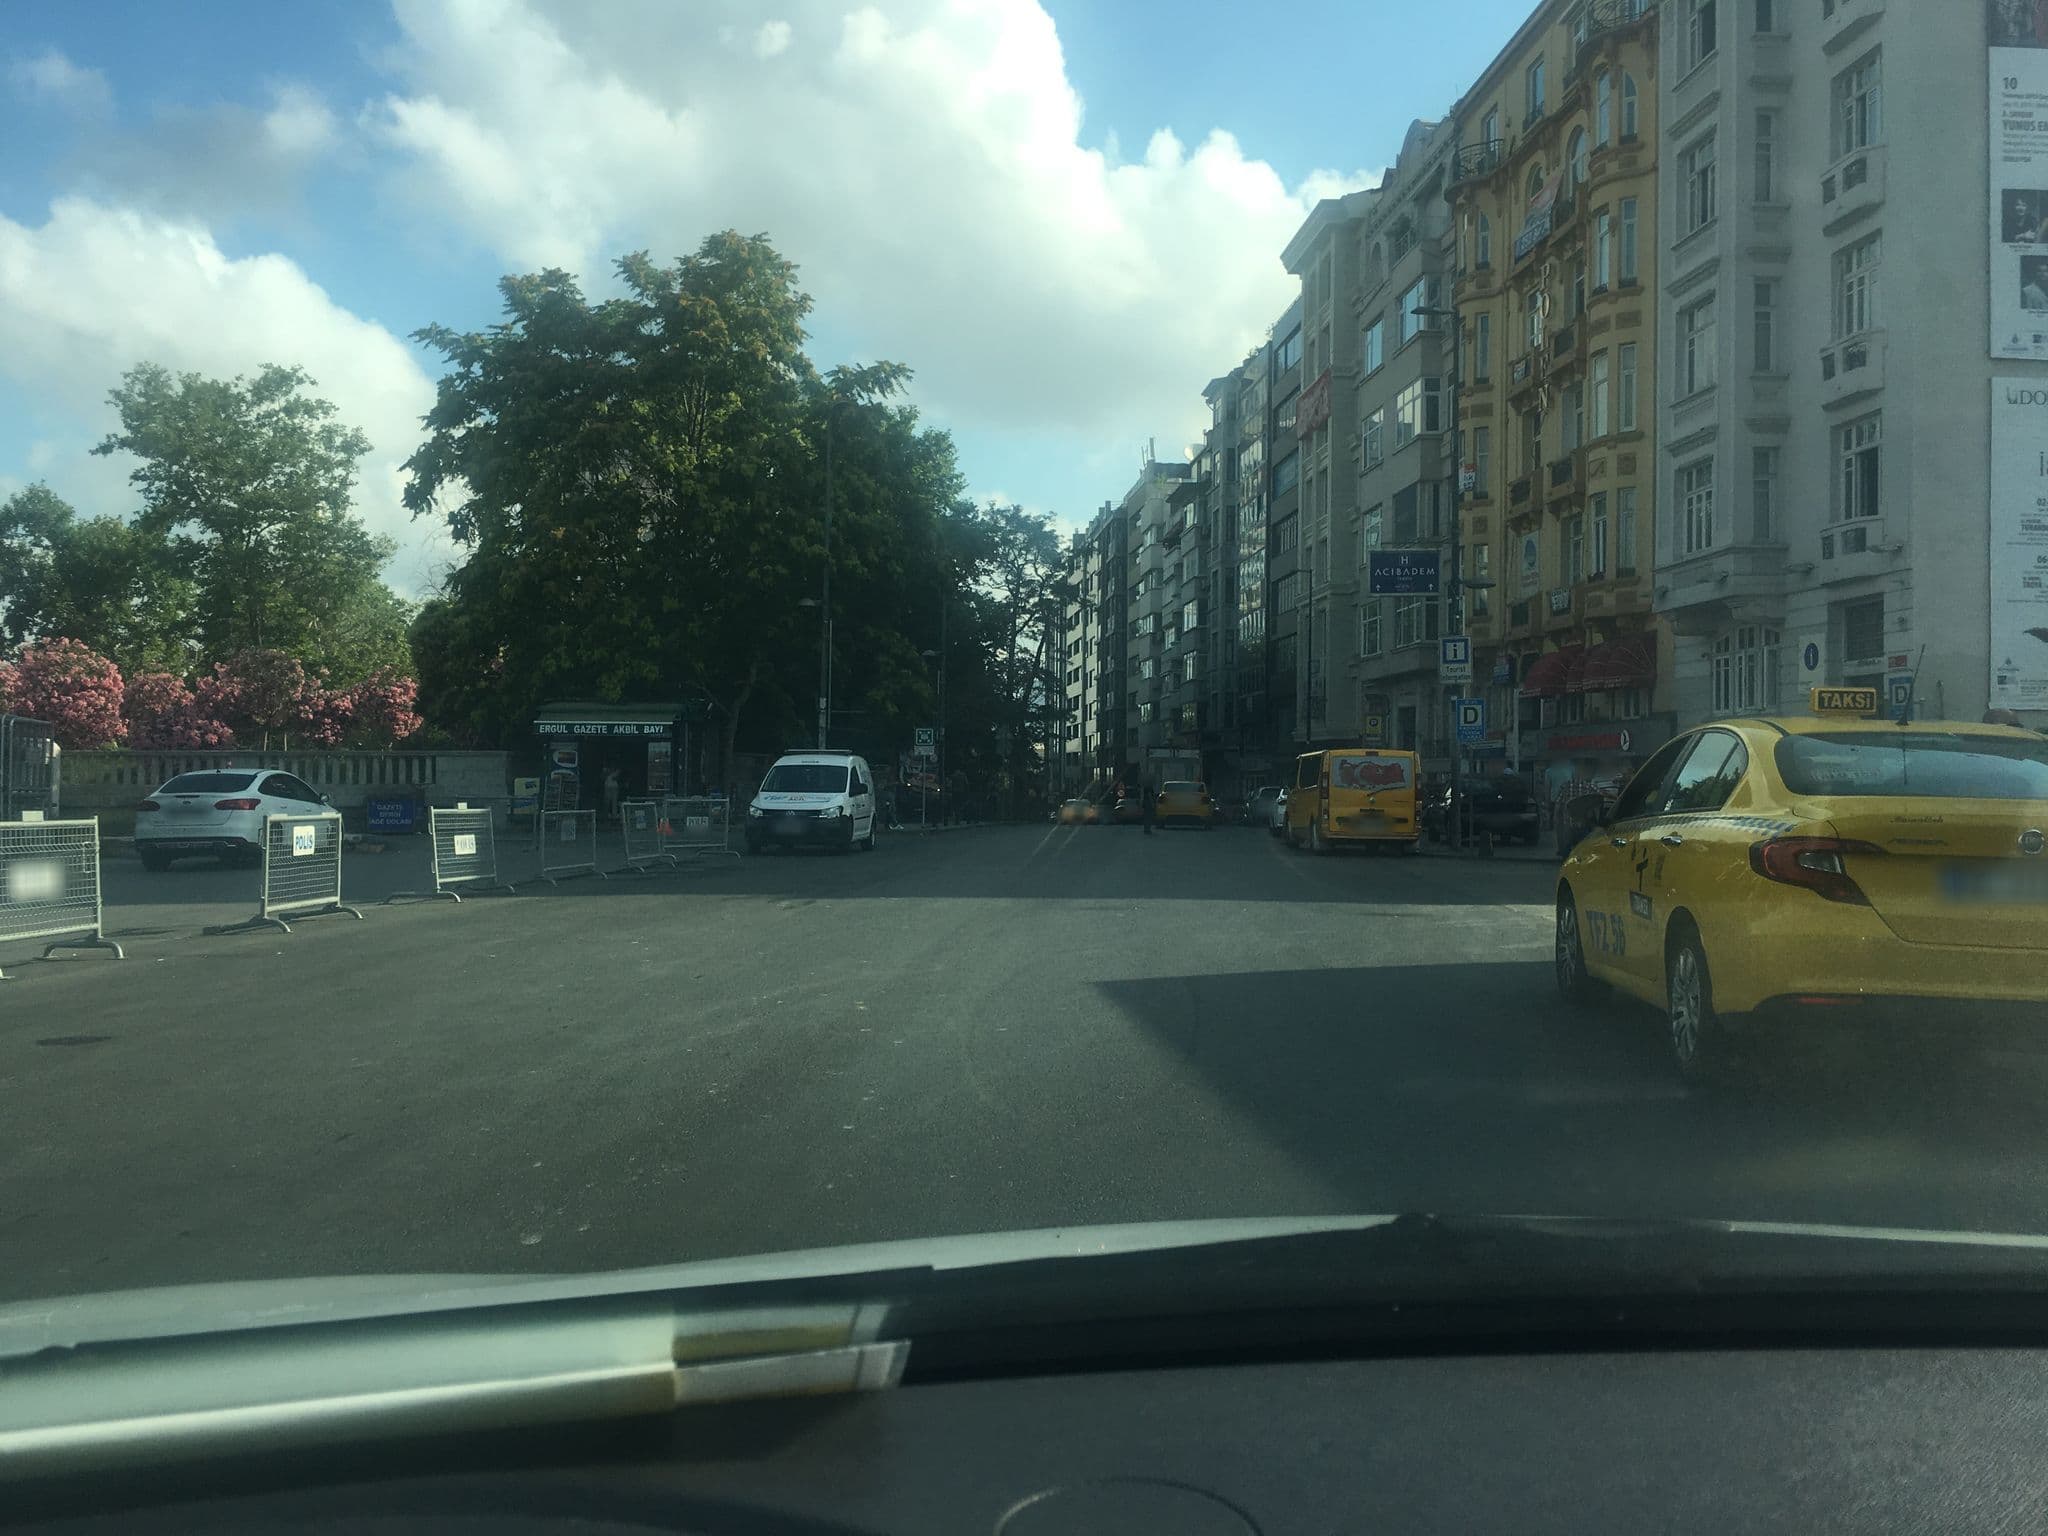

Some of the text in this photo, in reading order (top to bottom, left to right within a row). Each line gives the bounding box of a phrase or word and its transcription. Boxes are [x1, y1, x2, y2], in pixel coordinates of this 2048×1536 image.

[2003, 77, 2018, 89] 10
[1375, 568, 1434, 576] ACIBADEM
[1463, 707, 1478, 724] D
[573, 725, 607, 734] GAZETE
